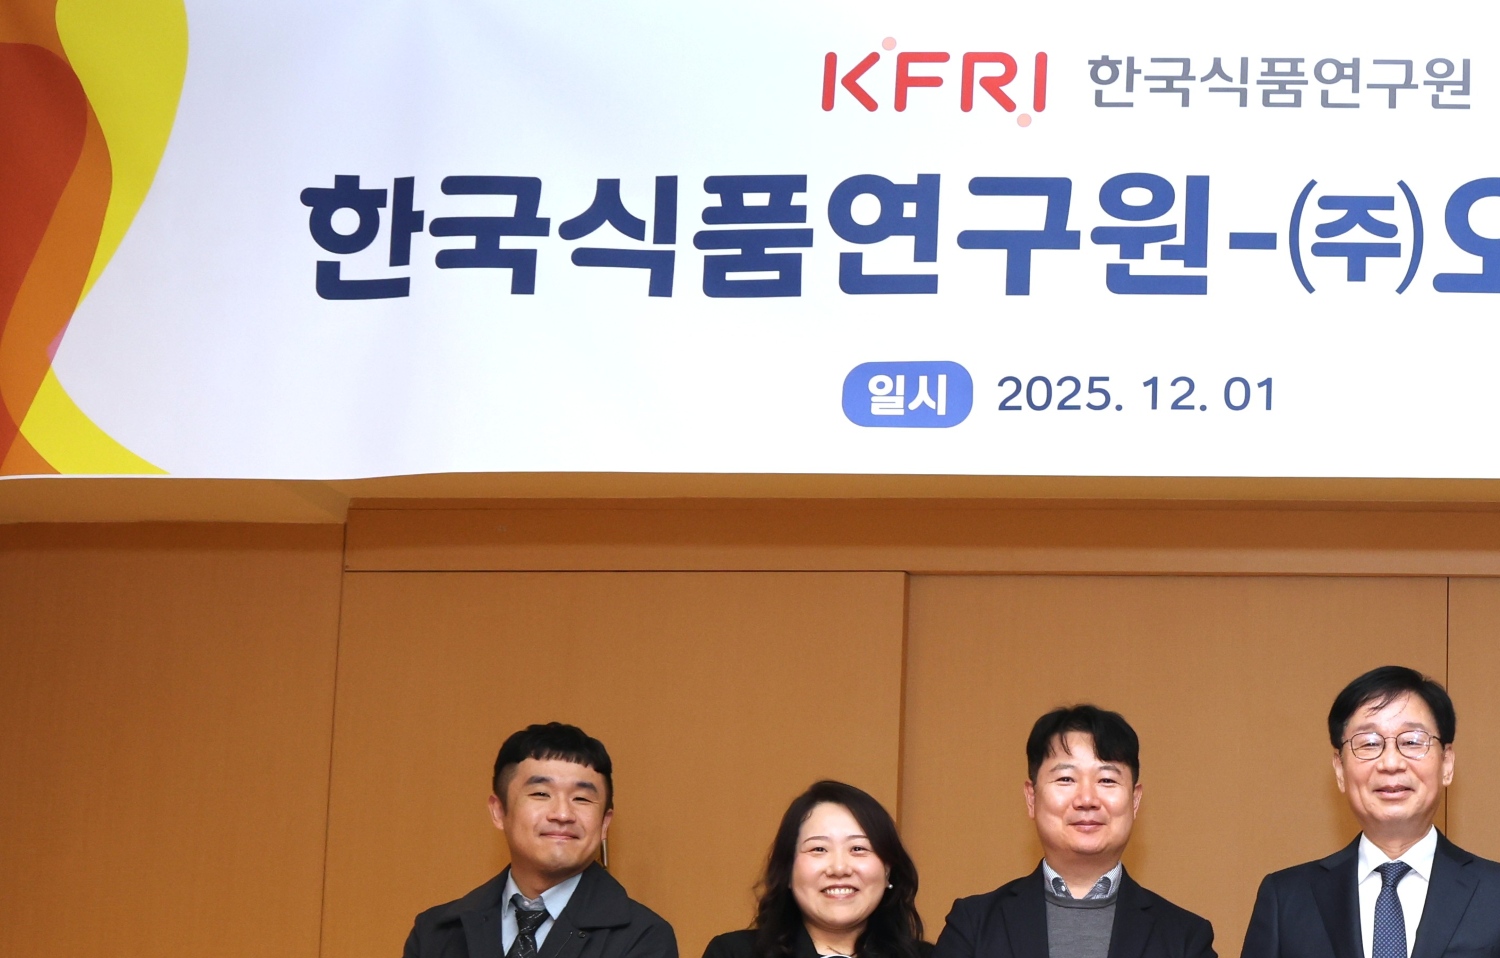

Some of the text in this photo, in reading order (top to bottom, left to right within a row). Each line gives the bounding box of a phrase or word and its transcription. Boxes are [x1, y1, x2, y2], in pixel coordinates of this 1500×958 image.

[821, 51, 1048, 113] KFRI
[1087, 54, 1471, 110] 한국식품연구원
[867, 374, 1273, 416] 일시 2025. 12. 01
